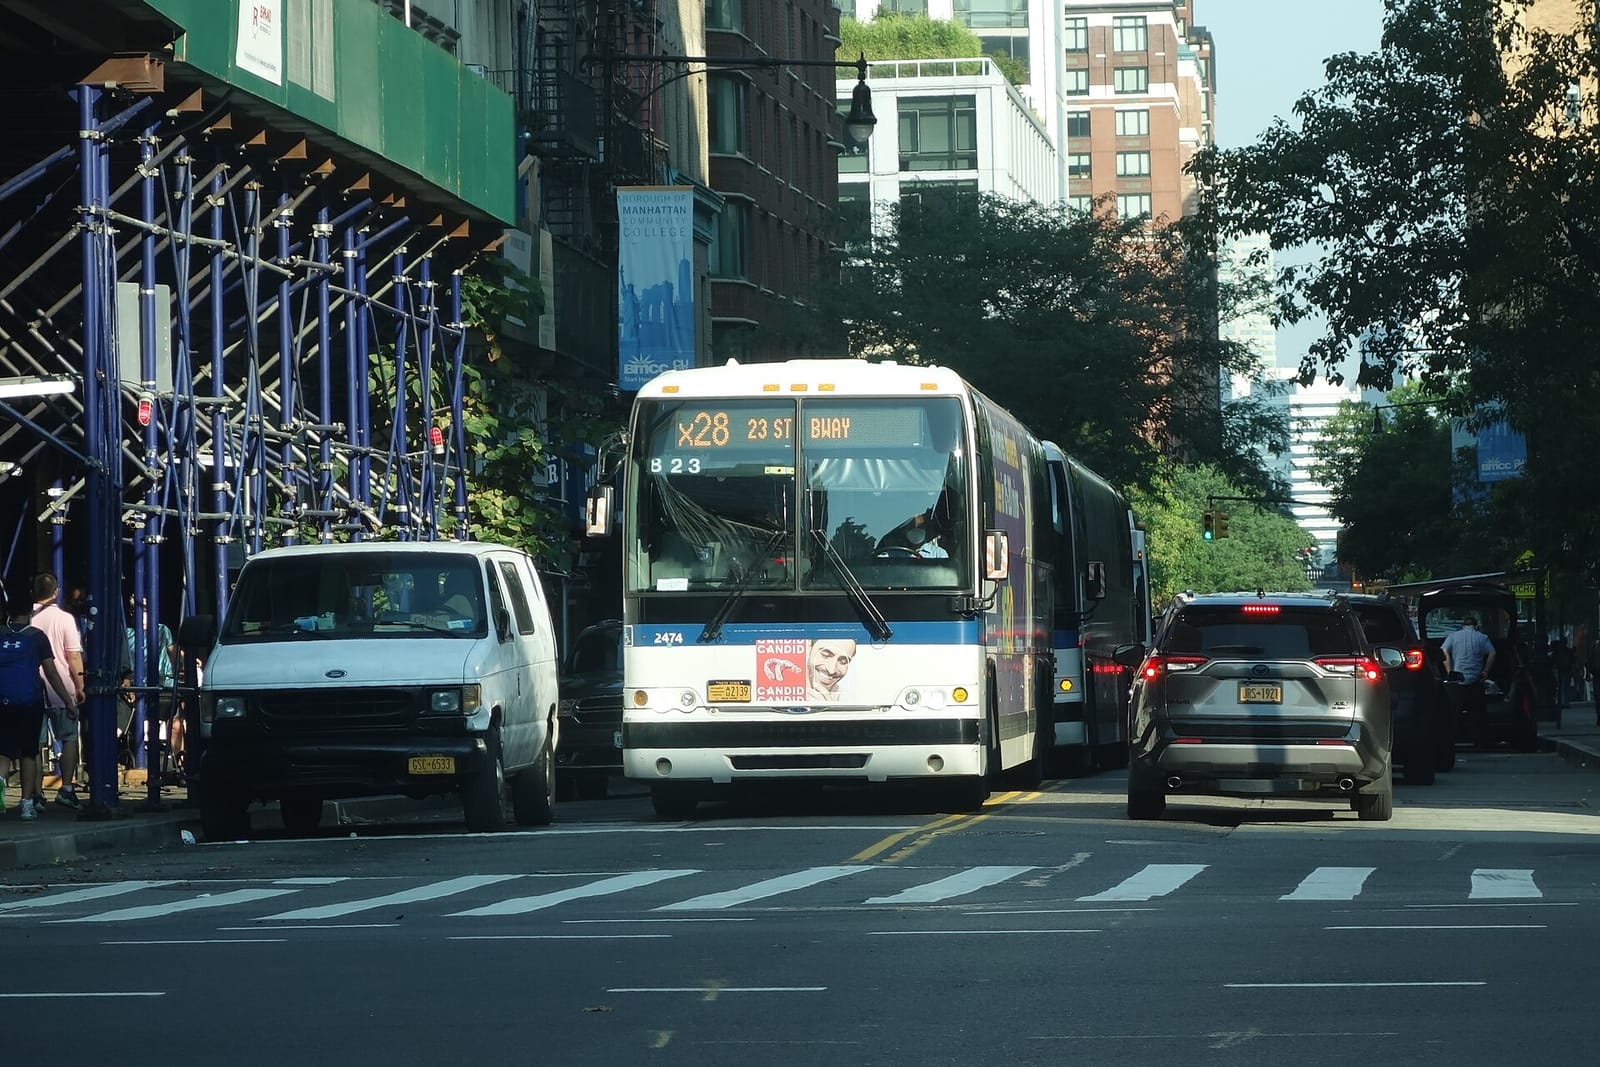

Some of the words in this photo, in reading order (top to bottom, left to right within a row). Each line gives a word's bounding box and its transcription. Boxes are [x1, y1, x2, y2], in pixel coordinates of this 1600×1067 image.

[622, 194, 671, 203] BOROUGH
[674, 194, 687, 203] OF
[622, 206, 687, 215] MANHATTAN
[622, 217, 687, 225] COMMUNITY
[623, 227, 686, 238] COLLEGE
[747, 418, 768, 439] 23
[773, 418, 792, 439] ST
[810, 417, 851, 439] BWAY
[653, 632, 684, 644] 2474
[757, 644, 805, 654] CANDID
[757, 686, 805, 696] CANDID
